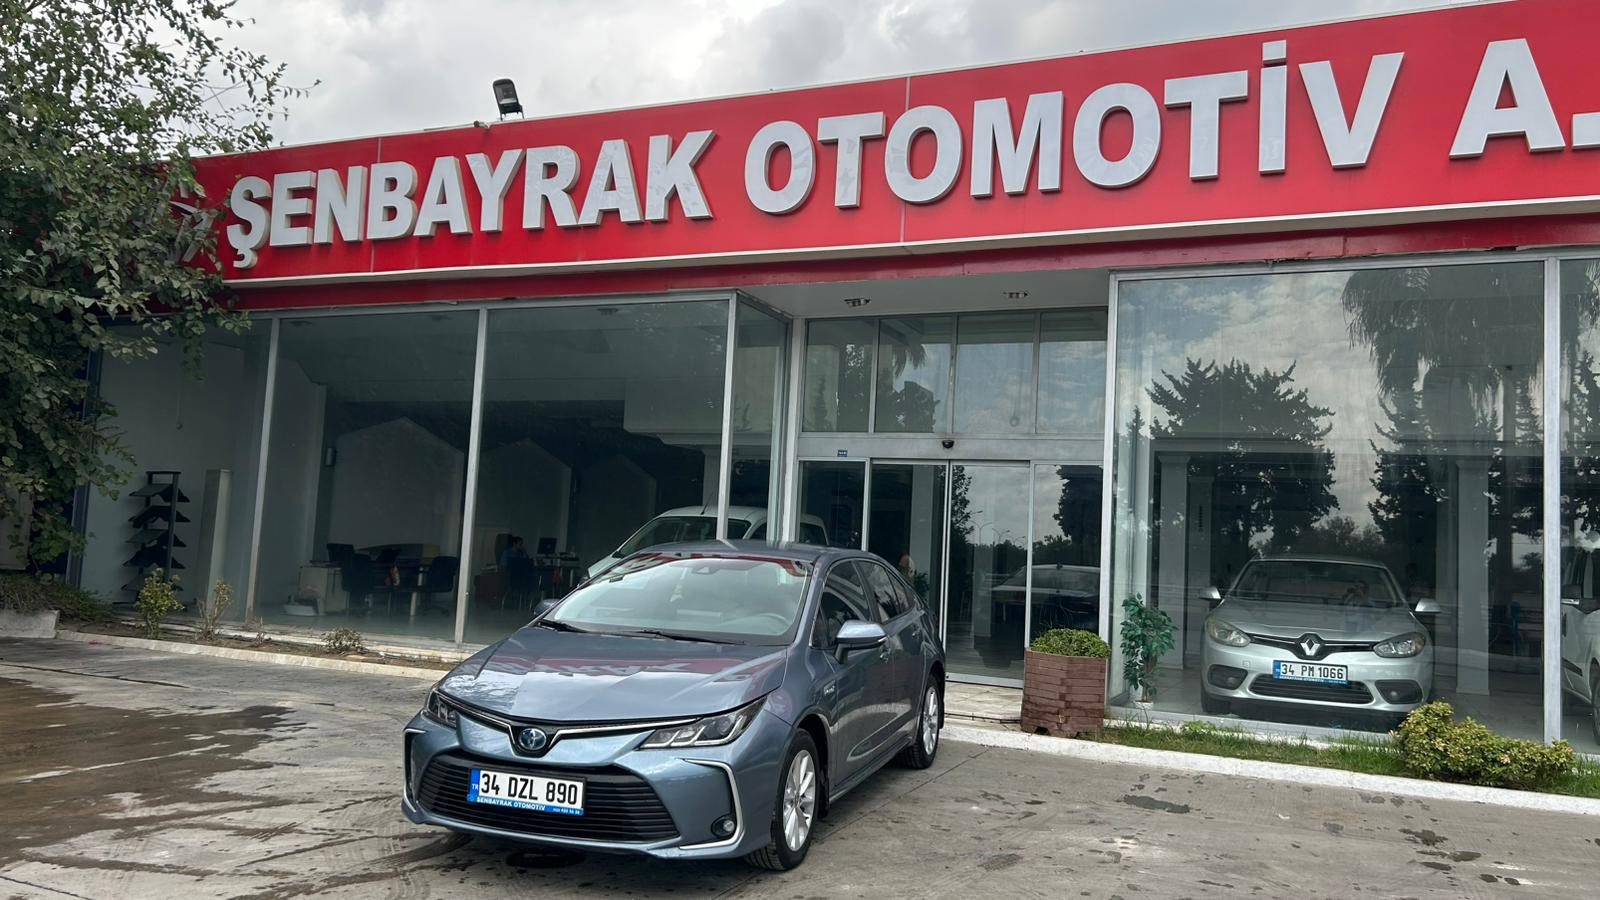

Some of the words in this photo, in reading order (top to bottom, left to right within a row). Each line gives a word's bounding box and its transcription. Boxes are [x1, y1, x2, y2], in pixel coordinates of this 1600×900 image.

[226, 129, 715, 269] ŞENBAYRAK
[744, 40, 1405, 215] OTOMOTİV
[1282, 664, 1294, 675] 34
[1301, 666, 1315, 677] PM
[1318, 666, 1344, 679] 1066
[481, 773, 500, 795] 34
[508, 777, 538, 800] DZL
[546, 782, 578, 805] 890
